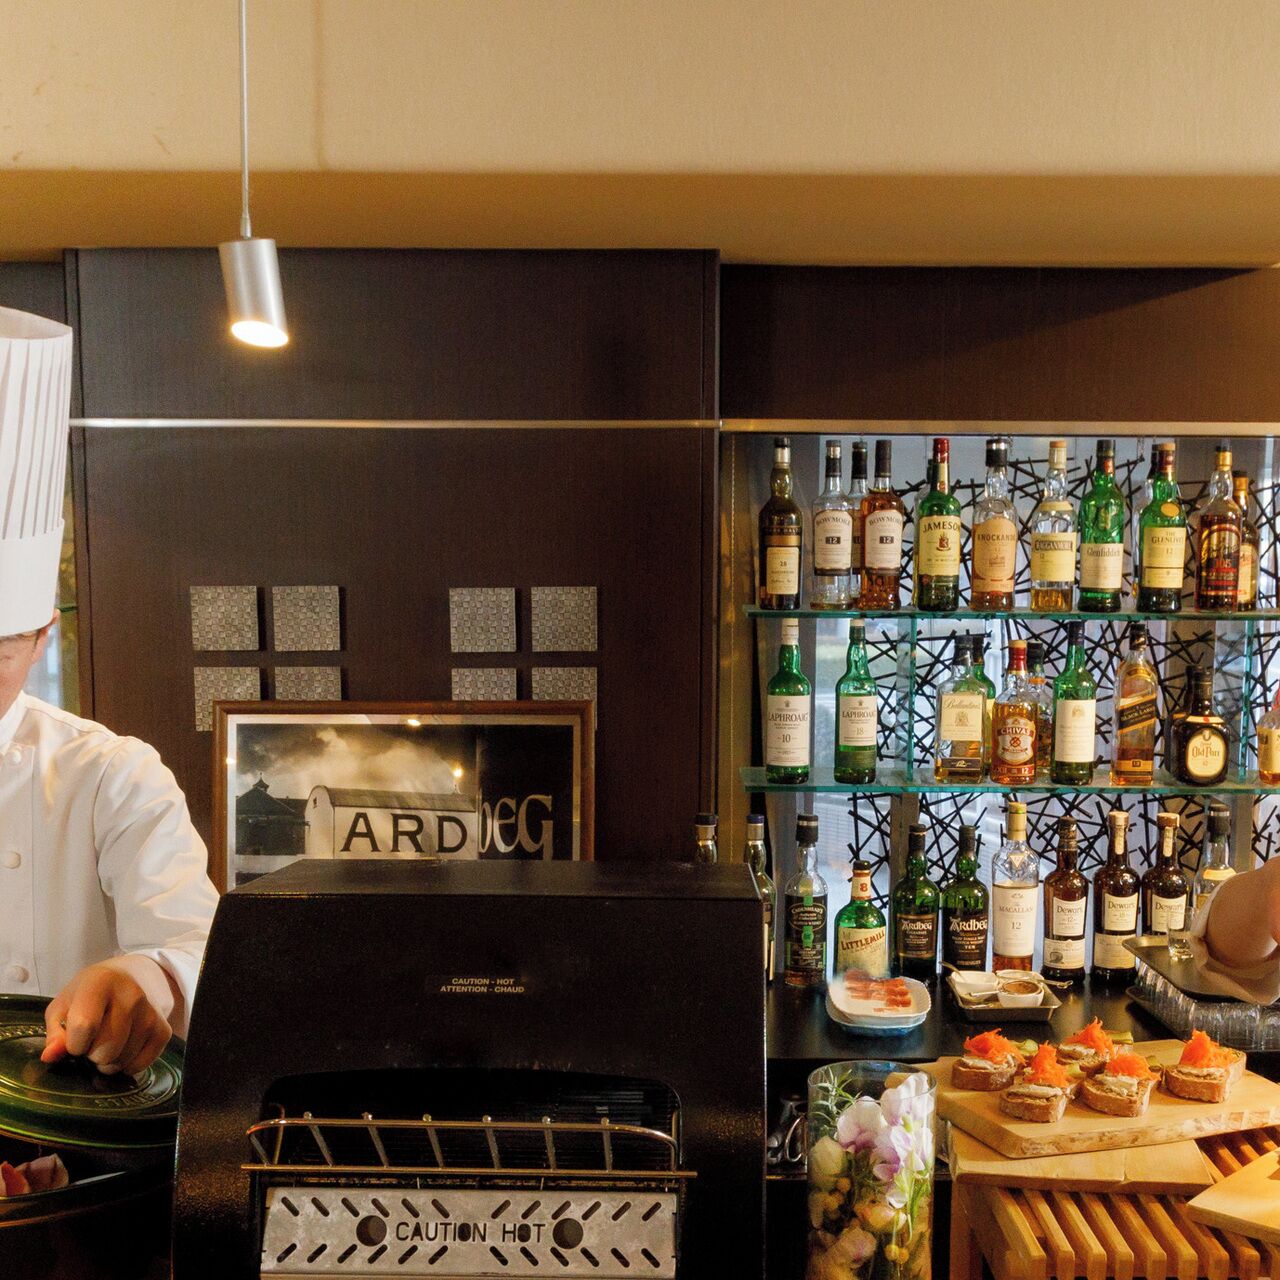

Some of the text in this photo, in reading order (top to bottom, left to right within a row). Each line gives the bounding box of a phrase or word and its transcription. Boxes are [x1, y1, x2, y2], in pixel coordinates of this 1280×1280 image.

[1001, 727, 1031, 735] CHIVAS
[782, 733, 791, 743] 10
[340, 812, 468, 853] ARD
[859, 882, 868, 891] 8
[1011, 921, 1022, 929] 12
[841, 929, 885, 950] LITTLEMILL
[440, 985, 487, 993] ATTENTION
[395, 1221, 546, 1243] CAUTION HOT
